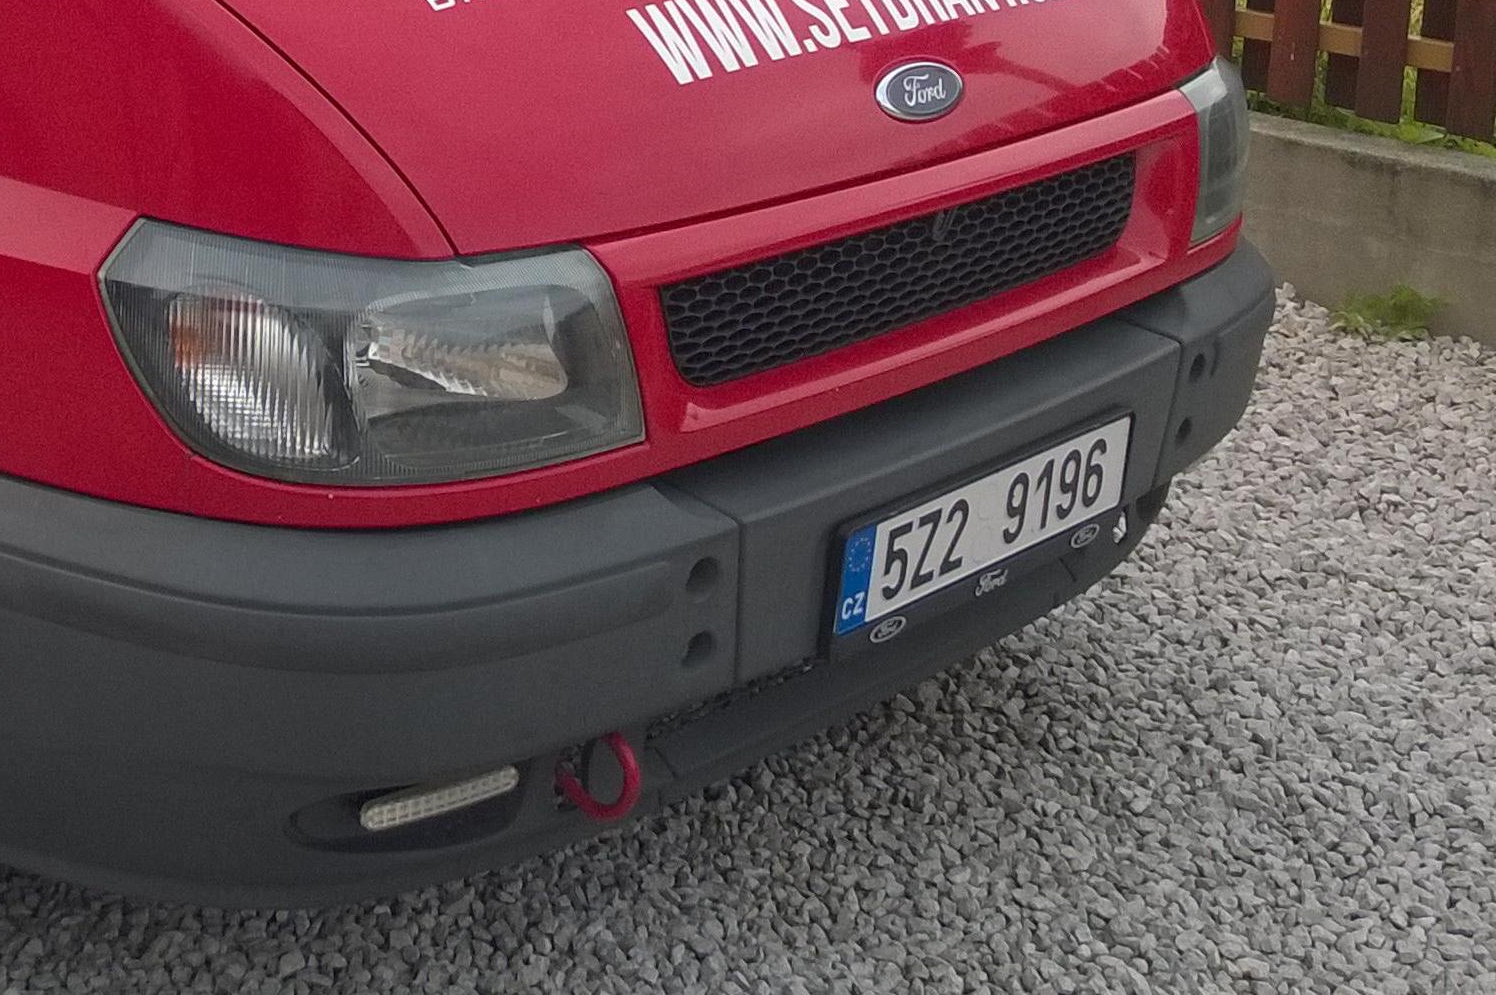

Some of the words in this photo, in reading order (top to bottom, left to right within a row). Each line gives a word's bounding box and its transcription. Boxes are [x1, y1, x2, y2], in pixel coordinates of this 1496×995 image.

[903, 73, 947, 107] Ford
[880, 497, 970, 601] 5Z2
[1002, 437, 1108, 545] 9196
[975, 568, 1009, 597] Ford
[840, 590, 865, 621] CZ
